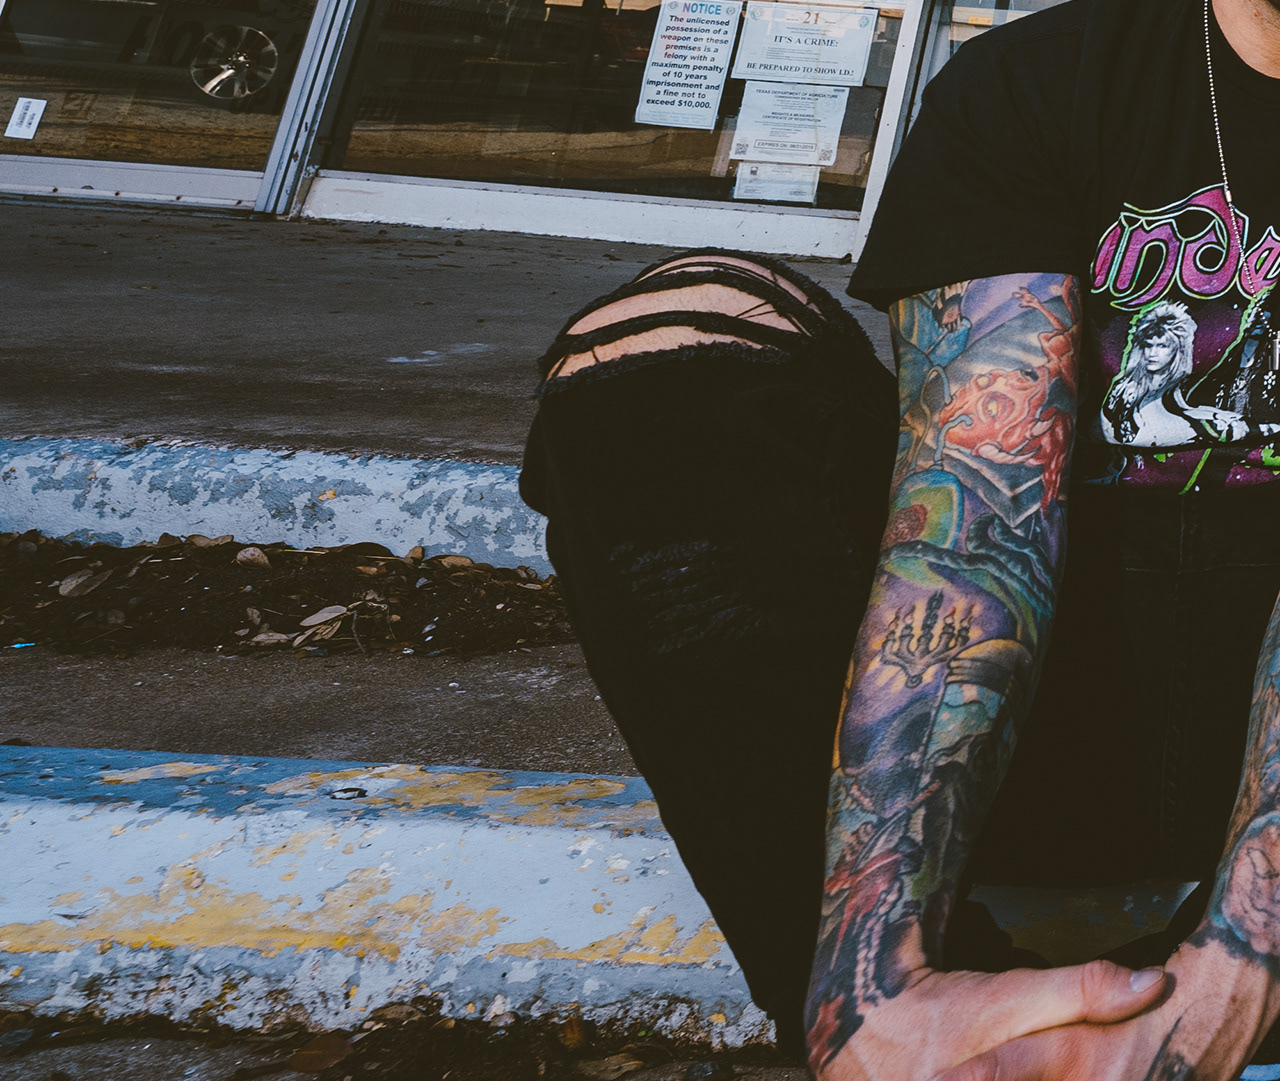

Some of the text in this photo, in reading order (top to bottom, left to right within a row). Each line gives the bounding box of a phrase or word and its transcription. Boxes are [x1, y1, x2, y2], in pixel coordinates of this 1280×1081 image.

[682, 2, 722, 15] NOTICE
[669, 14, 730, 26] The unlicensed
[802, 11, 821, 25] 21
[665, 24, 711, 34] possession
[660, 33, 692, 42] weapon
[706, 37, 729, 45] these
[774, 35, 793, 44] IT'S
[803, 37, 839, 47] CRIME:
[665, 43, 702, 52] premises
[663, 52, 688, 61] felony
[690, 53, 708, 62] with
[651, 61, 724, 74] maximum penalty
[758, 63, 801, 73] PREPARED
[802, 66, 813, 74] TO
[813, 67, 839, 75] SHOW
[662, 70, 708, 81] of 10 years
[646, 78, 721, 91] imprisonment and
[663, 88, 679, 97] fine
[681, 90, 696, 99] not
[697, 91, 707, 99] to
[646, 98, 712, 110] exceed $10,000.
